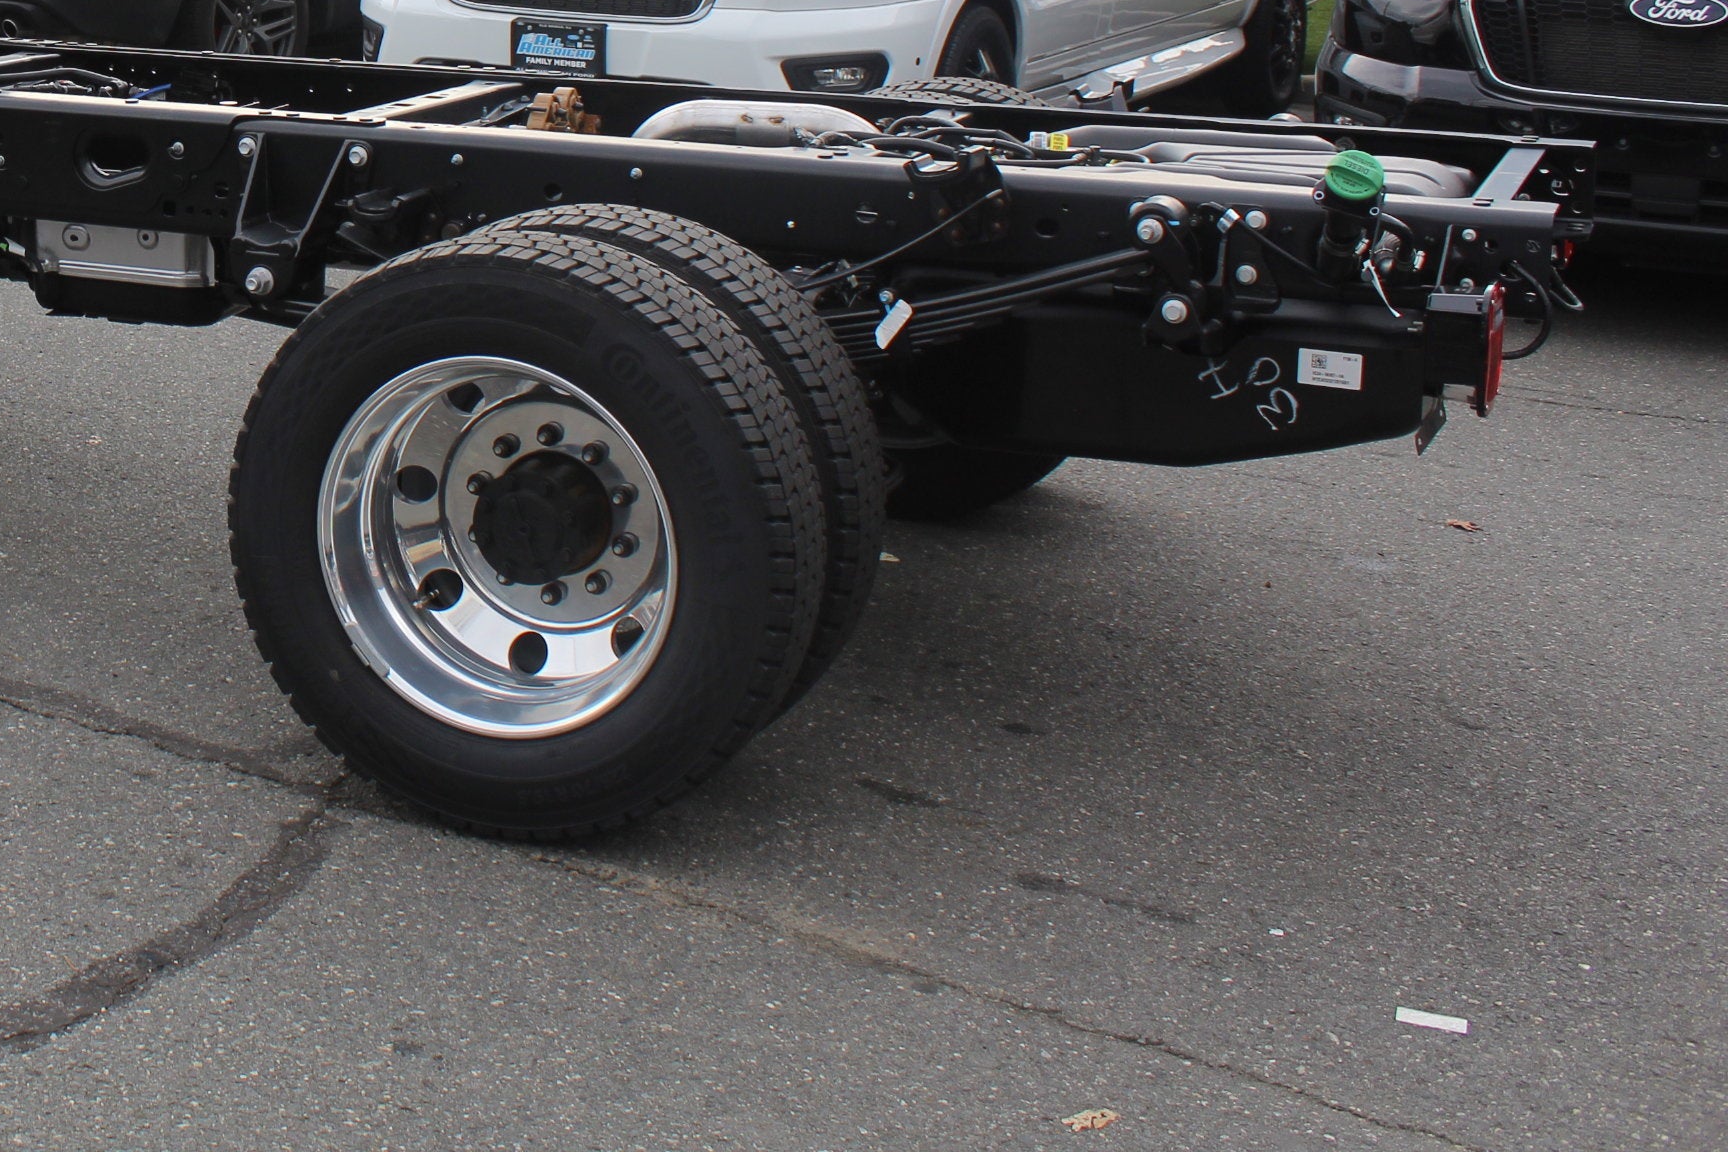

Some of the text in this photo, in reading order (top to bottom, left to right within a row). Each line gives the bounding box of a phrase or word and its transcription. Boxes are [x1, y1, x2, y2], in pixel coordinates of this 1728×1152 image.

[525, 56, 587, 68] FAMILY MEMBER
[1344, 158, 1370, 175] DIESEL
